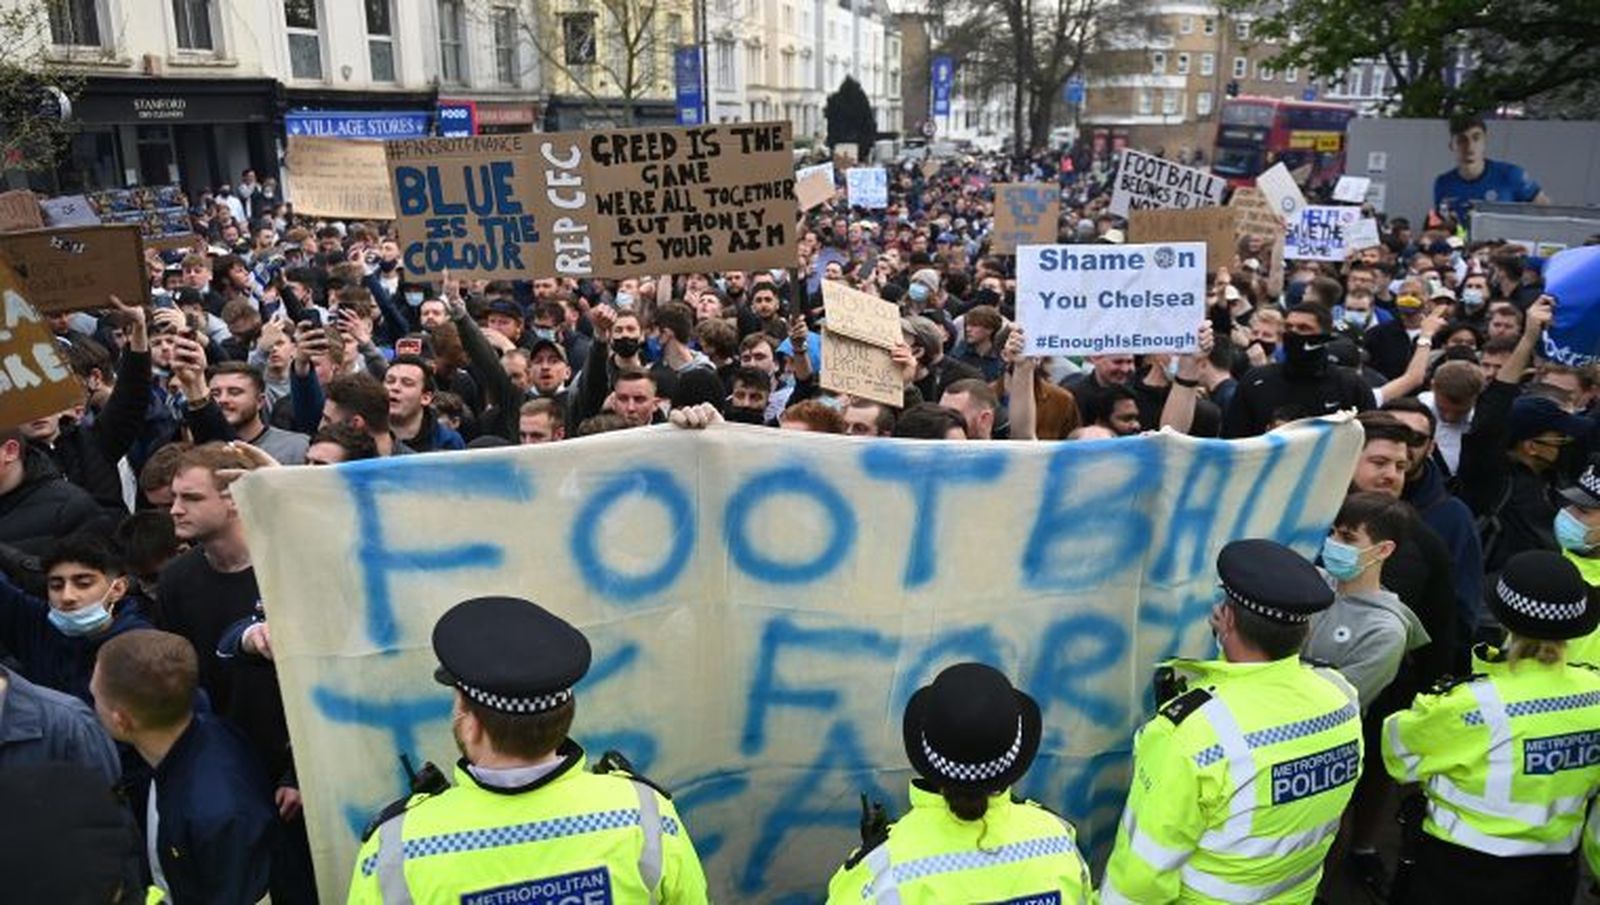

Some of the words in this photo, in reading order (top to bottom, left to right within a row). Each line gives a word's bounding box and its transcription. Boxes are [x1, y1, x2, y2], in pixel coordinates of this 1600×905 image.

[134, 98, 186, 110] STANFORD
[441, 109, 469, 118] FOOD
[302, 119, 365, 136] VILLAGE
[367, 117, 414, 134] STORES
[590, 131, 677, 166] GREED
[686, 127, 721, 160] IS
[730, 126, 785, 154] THE
[395, 161, 524, 216] BLUE
[541, 142, 586, 209] CFC
[641, 162, 711, 189] GAME
[1120, 173, 1172, 204] BELONGS
[1173, 190, 1191, 209] TO
[1123, 151, 1214, 199] FOOTBALL
[595, 188, 656, 216] WE'RE
[661, 189, 697, 214] ALL
[703, 178, 799, 208] TOGETHER
[424, 216, 468, 239] IS
[478, 214, 540, 244] THE
[617, 215, 669, 236] BUT
[682, 208, 767, 232] MONEY
[403, 241, 526, 276] COLOUR
[611, 239, 647, 266] IS
[656, 235, 713, 260] YOUR
[1039, 248, 1145, 271] Shame
[1039, 292, 1087, 309] You
[1098, 290, 1195, 309] Chelsea
[1035, 331, 1196, 351] #EnoughIsEnough
[0, 343, 69, 394] KE
[335, 419, 1334, 650] FOOTBALL
[1273, 742, 1358, 779] METROPOLITAN
[1273, 756, 1358, 803] POLICE
[467, 872, 605, 905] METROPOLITAN
